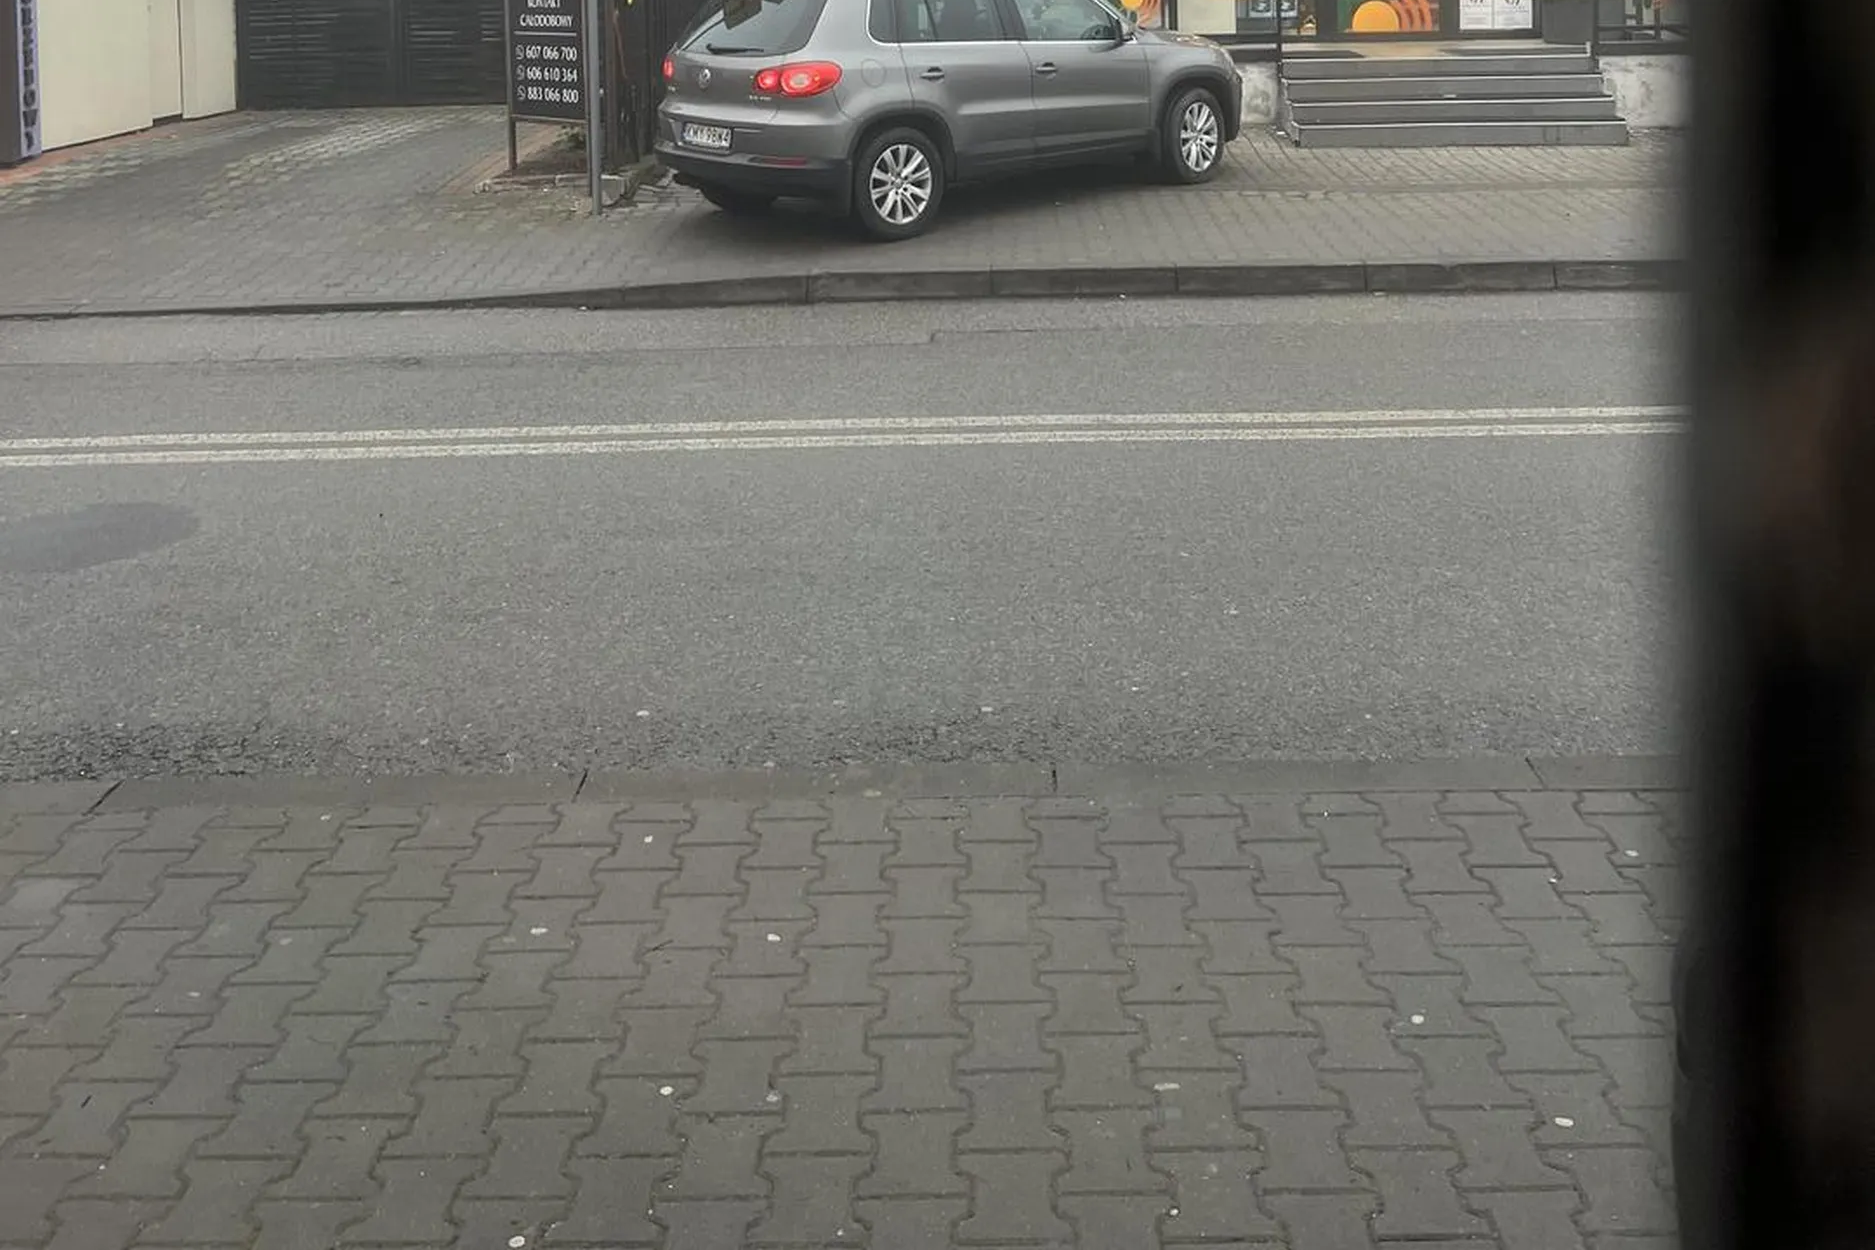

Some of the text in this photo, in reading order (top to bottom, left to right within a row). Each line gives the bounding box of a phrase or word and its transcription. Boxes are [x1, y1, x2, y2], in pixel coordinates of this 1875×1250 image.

[526, 45, 541, 60] 607
[561, 46, 577, 61] 700
[562, 88, 579, 103] 800
